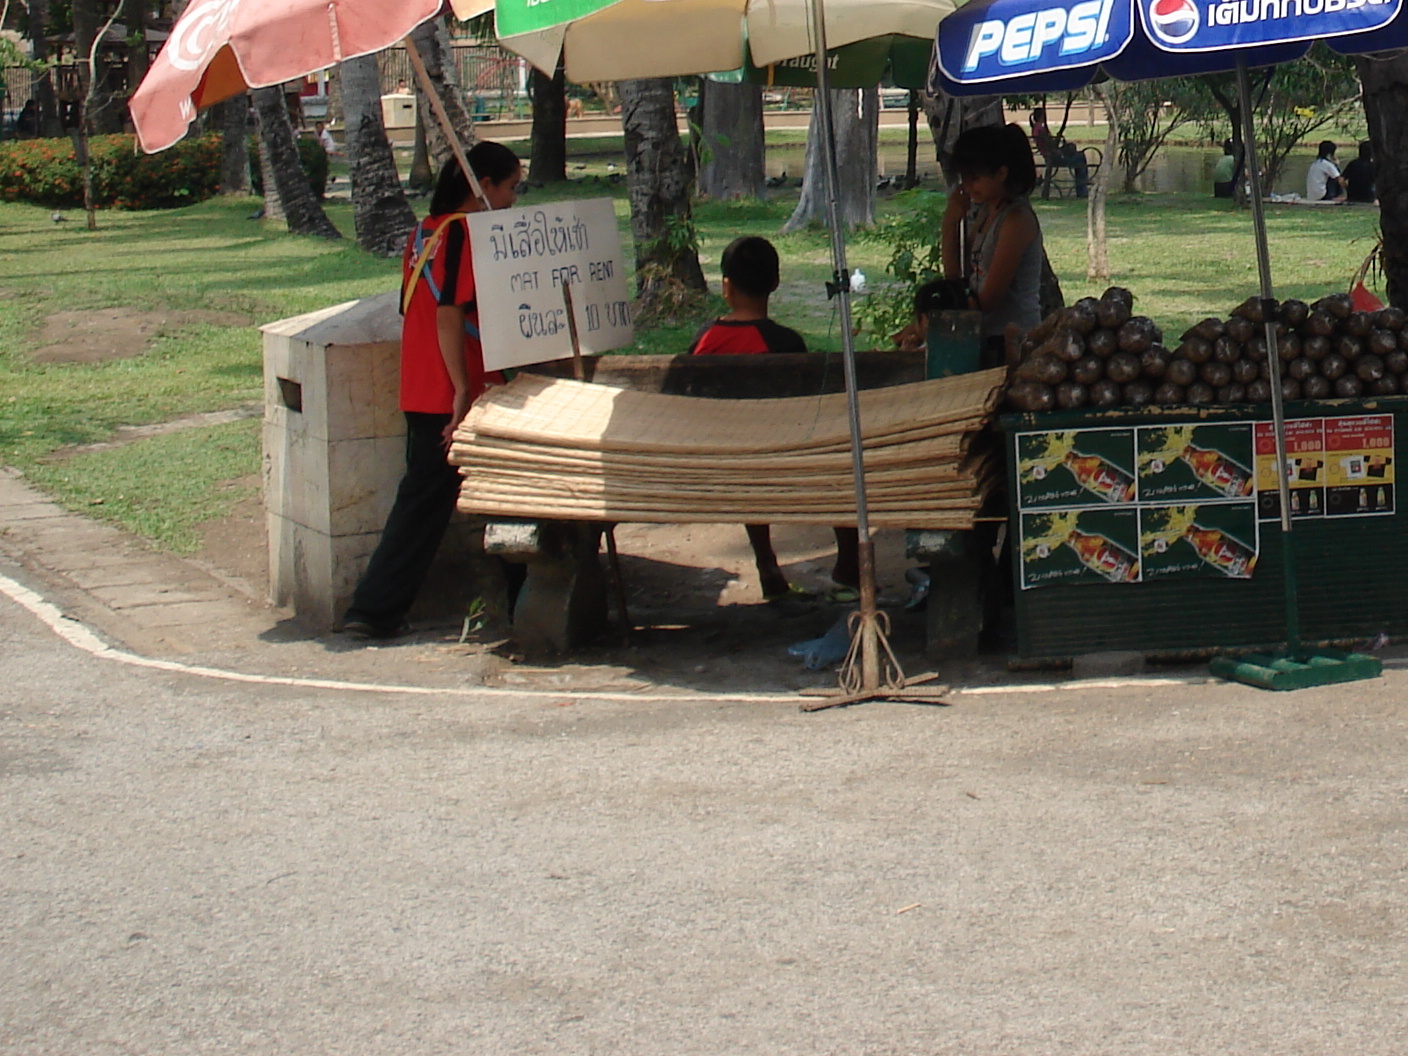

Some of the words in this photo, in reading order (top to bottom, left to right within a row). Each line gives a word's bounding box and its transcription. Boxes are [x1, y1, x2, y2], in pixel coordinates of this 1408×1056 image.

[510, 271, 538, 293] MAT
[551, 264, 582, 288] FOR
[589, 260, 614, 282] RENT
